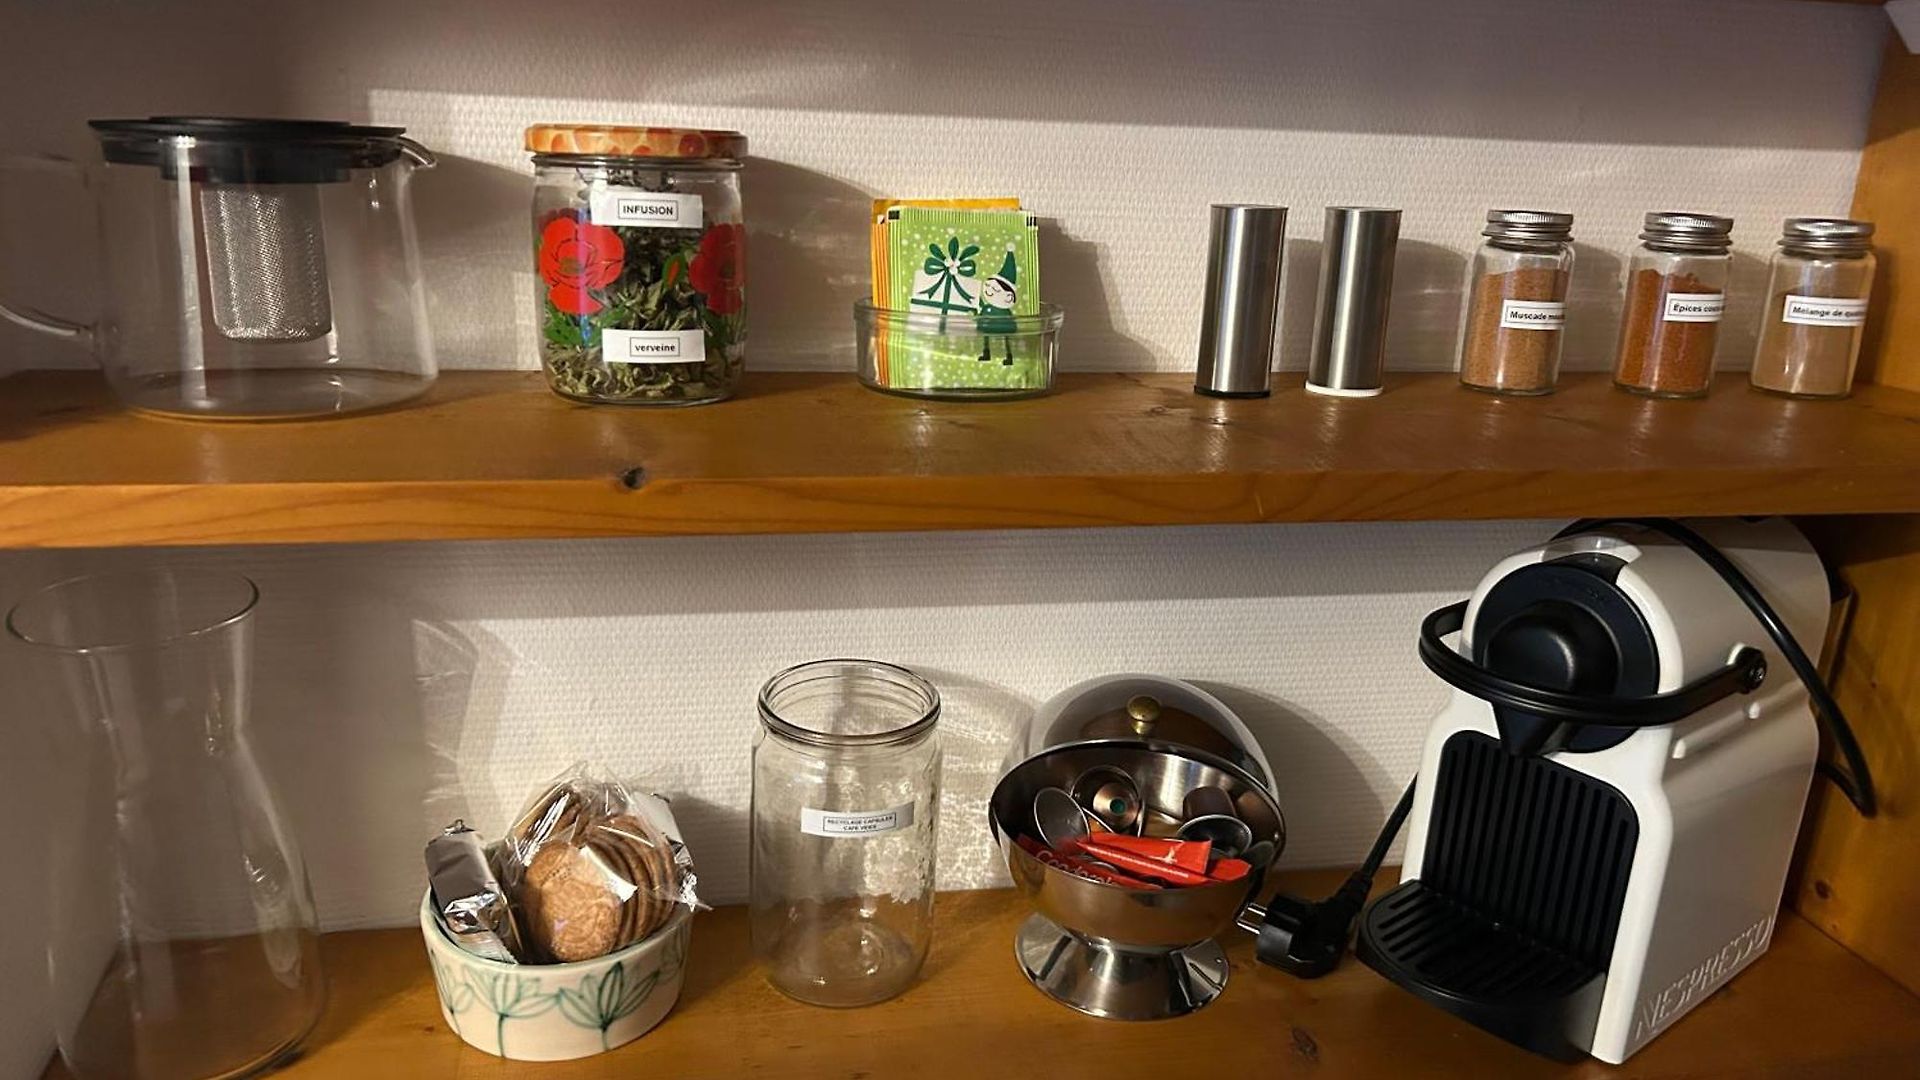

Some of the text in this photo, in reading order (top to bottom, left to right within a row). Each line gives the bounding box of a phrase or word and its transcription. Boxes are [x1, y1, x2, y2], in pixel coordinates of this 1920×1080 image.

[623, 205, 674, 216] INFUSION
[1510, 311, 1547, 320] Muscade
[635, 344, 676, 352] verveine
[1634, 915, 1775, 1041] NESPRESSO
